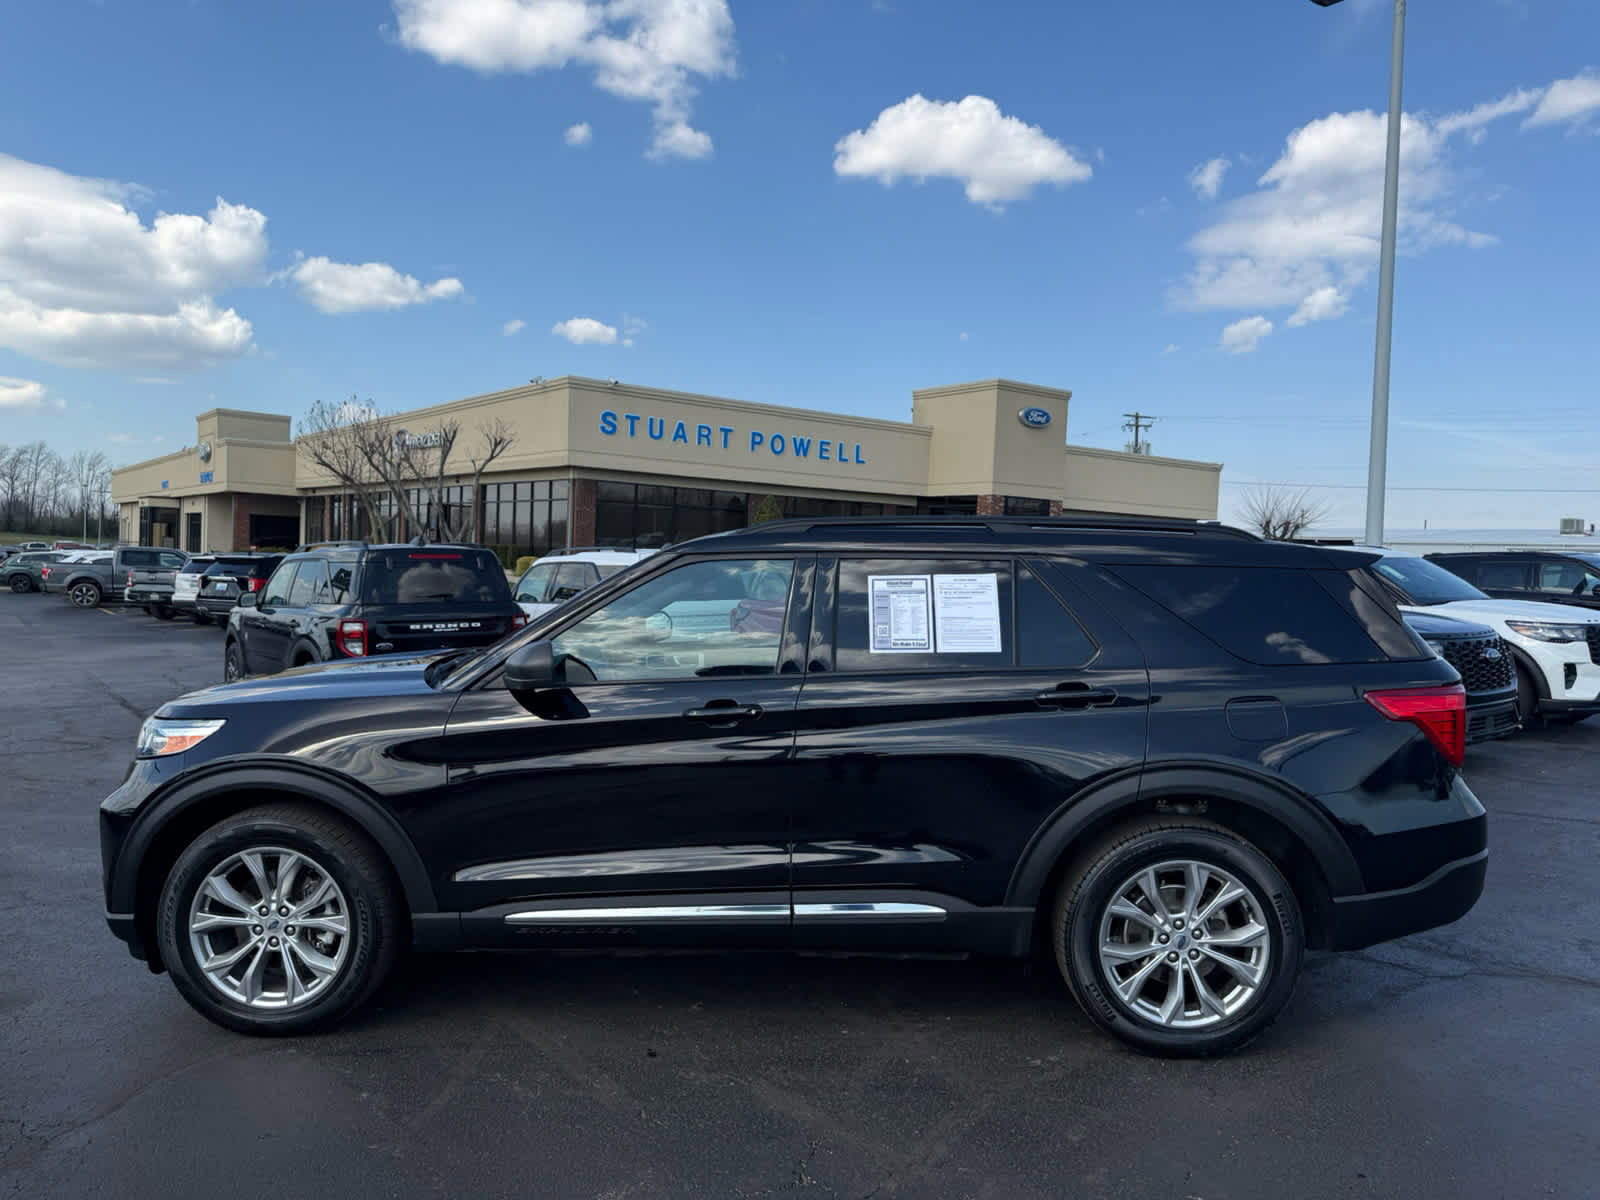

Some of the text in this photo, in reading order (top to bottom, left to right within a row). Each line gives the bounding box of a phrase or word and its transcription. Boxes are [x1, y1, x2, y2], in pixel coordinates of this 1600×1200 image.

[1028, 410, 1048, 424] Ford
[600, 410, 867, 465] STUART POWELL
[409, 622, 481, 630] BRONCO
